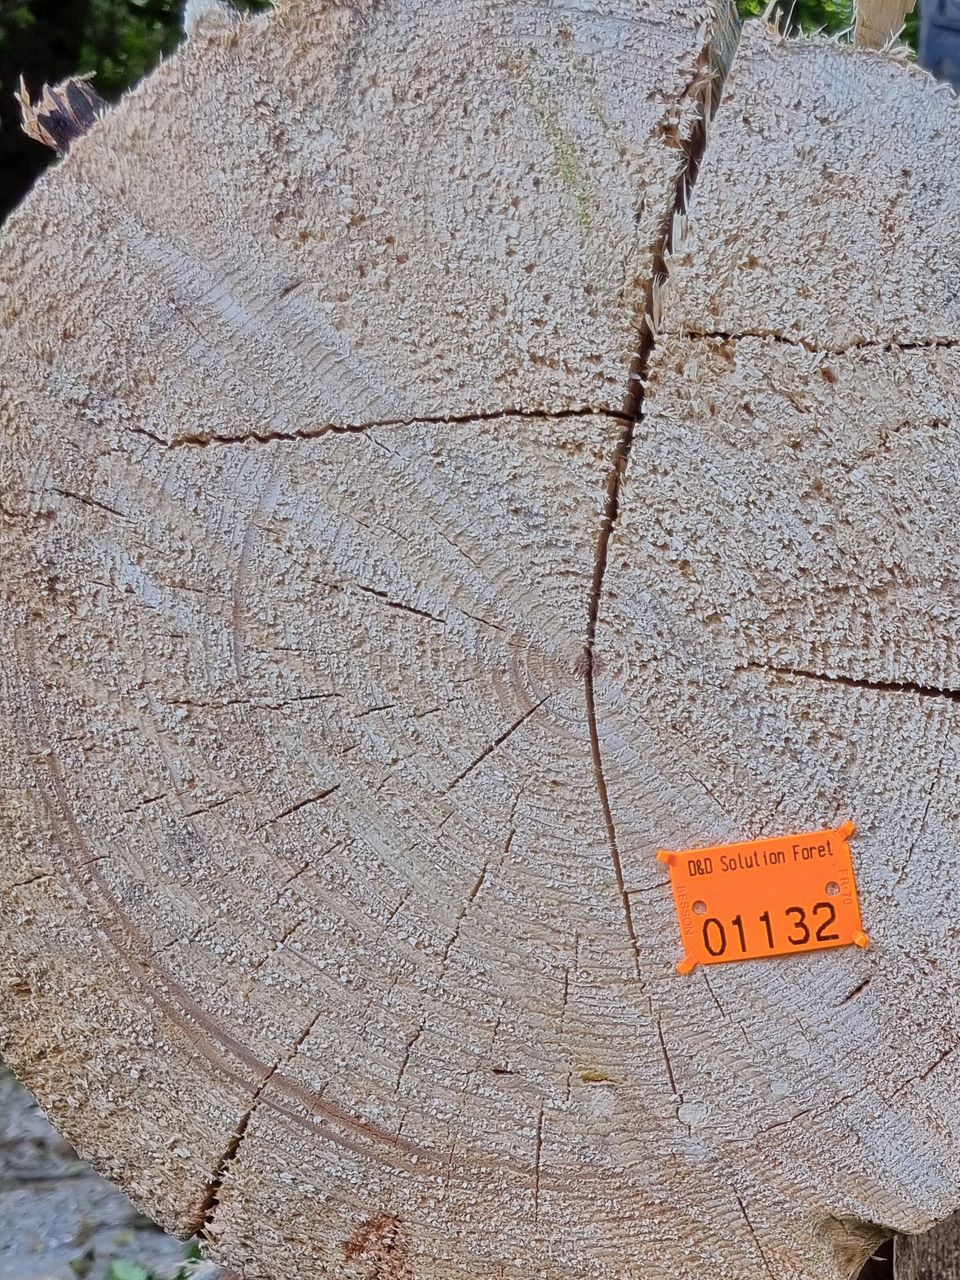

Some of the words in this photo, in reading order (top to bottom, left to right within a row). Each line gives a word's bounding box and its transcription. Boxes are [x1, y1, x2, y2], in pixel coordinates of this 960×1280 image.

[688, 857, 713, 877] D&D
[720, 851, 786, 872] Solution
[792, 840, 834, 862] Foret
[676, 885, 694, 937] BESSON
[702, 902, 840, 957] 01132
